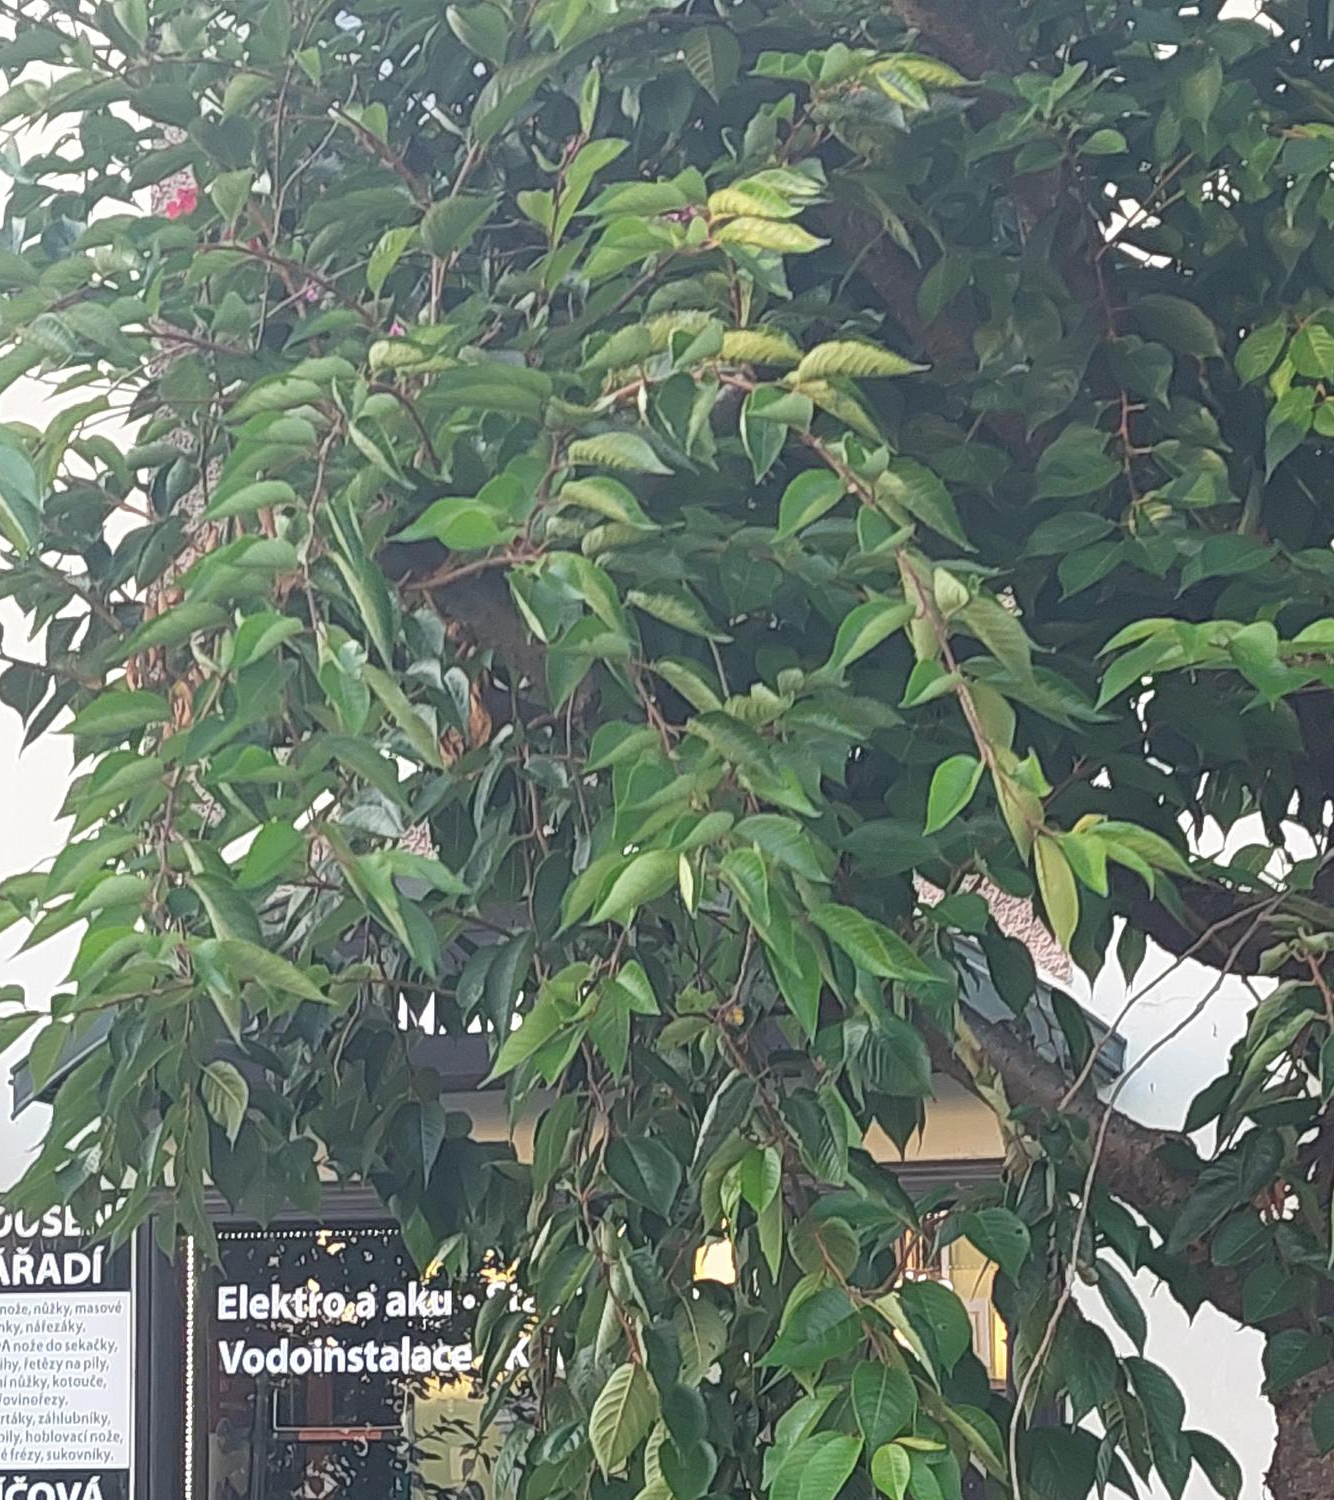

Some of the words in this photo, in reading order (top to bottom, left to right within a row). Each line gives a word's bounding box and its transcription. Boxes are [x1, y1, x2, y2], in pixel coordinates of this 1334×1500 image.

[217, 1284, 347, 1321] Elektro
[356, 1288, 376, 1318] a
[385, 1282, 453, 1318] aku
[0, 1303, 31, 1316] nože,
[34, 1302, 72, 1317] nůžky,
[75, 1302, 122, 1314] masové
[13, 1341, 43, 1352] nože
[46, 1340, 62, 1352] do
[65, 1340, 117, 1354] sekačky,
[218, 1337, 473, 1375] Vodoinstalace
[24, 1358, 63, 1372] řetězy
[66, 1360, 80, 1369] na
[84, 1356, 109, 1372] pily,
[10, 1376, 50, 1389] nůžky,
[53, 1376, 107, 1389] kotouče,
[25, 1430, 87, 1443] hoblovací
[90, 1432, 123, 1444] nože,
[10, 1449, 43, 1463] frézy,
